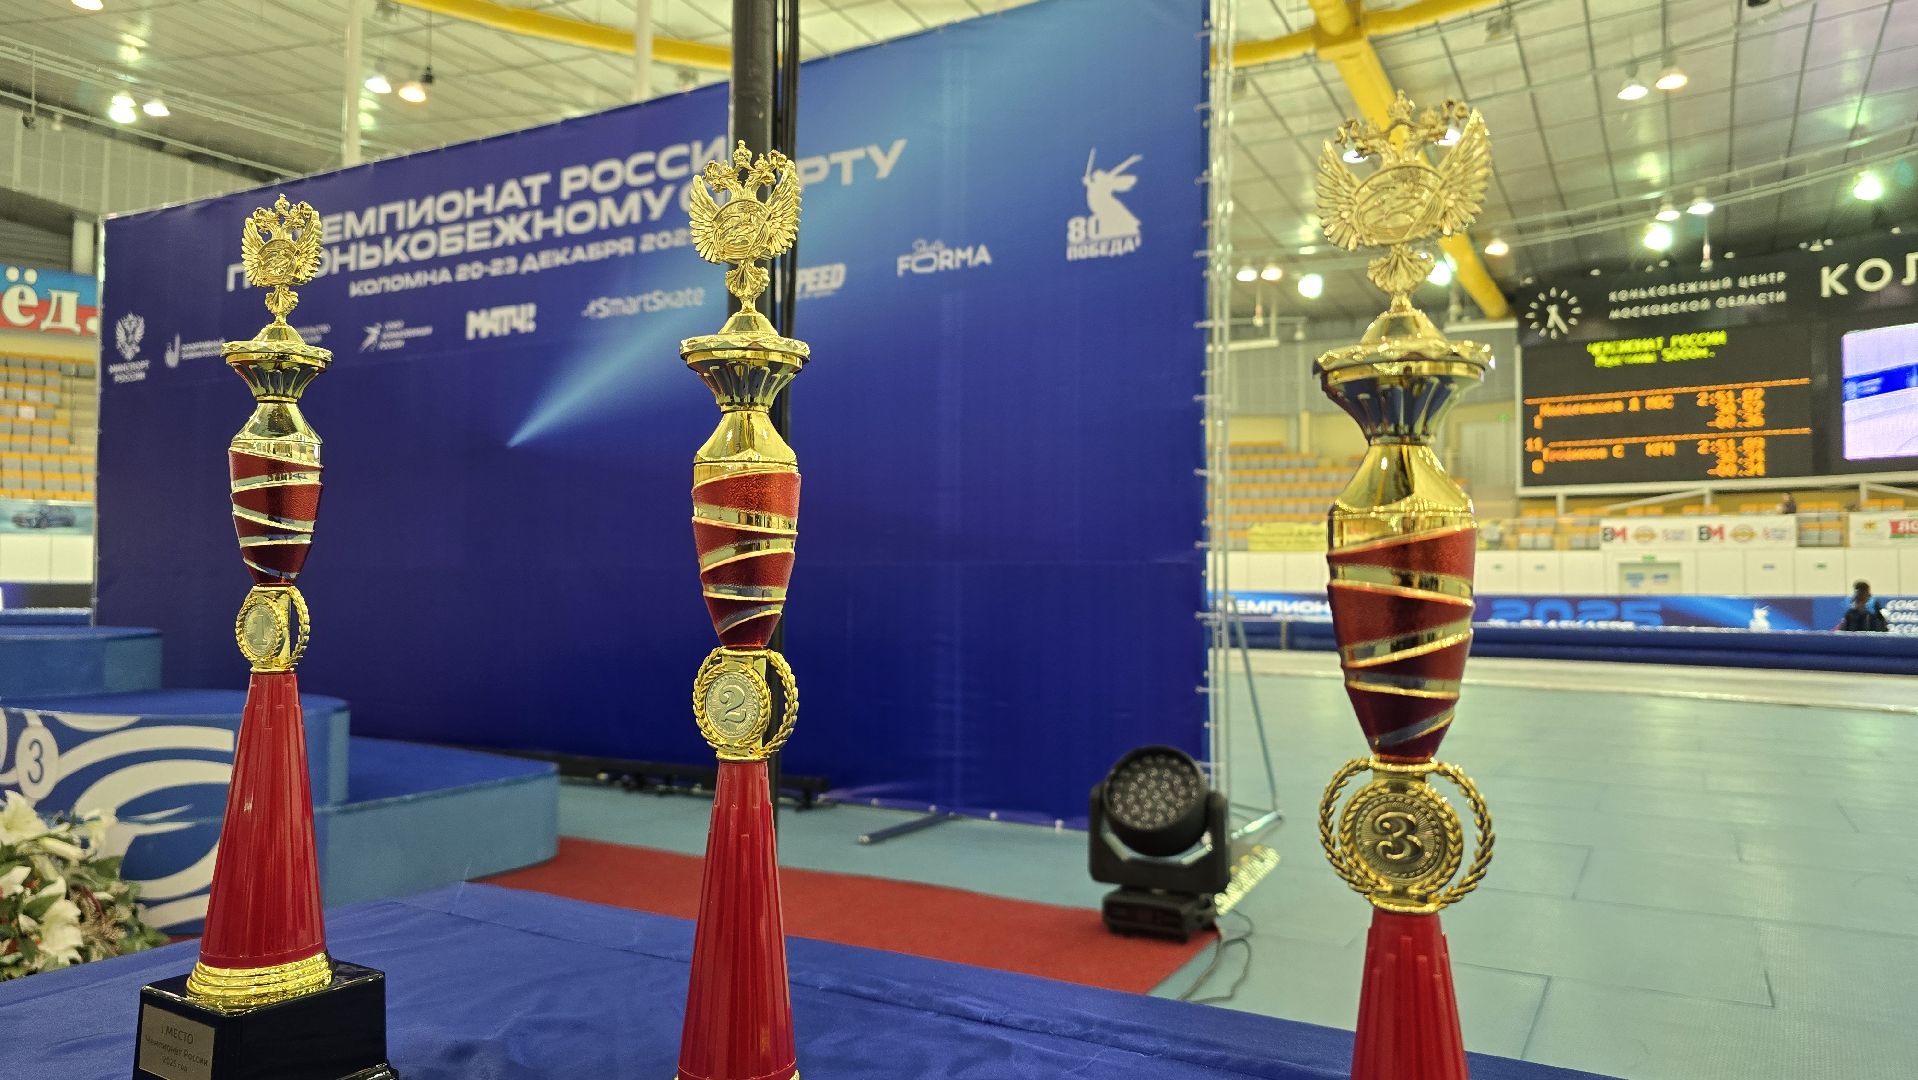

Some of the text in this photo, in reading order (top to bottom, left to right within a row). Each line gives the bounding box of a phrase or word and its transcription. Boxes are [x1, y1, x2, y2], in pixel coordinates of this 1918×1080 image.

[306, 135, 728, 247] ЕМПИОНАТ РОССИ
[317, 182, 675, 280] ОНЬКОБЕЖНОМУ
[678, 138, 908, 214] СРТУ
[349, 228, 690, 297] КОЛОМНА 20-23 ДЕКАБРЯ 202
[896, 243, 992, 278] FORMA
[1608, 271, 1787, 303] КОНЬКОБЕЖНЫЙ ЦЕНТР
[1608, 290, 1787, 320] МОСКОВСКОЙ ОБЛАСТИ
[1213, 599, 1331, 617] ЕМПИОН
[1491, 598, 1665, 626] 2025
[718, 683, 748, 724] 2
[28, 738, 44, 784] 3
[1372, 811, 1424, 862] 3
[166, 1026, 194, 1045] МЕСТО
